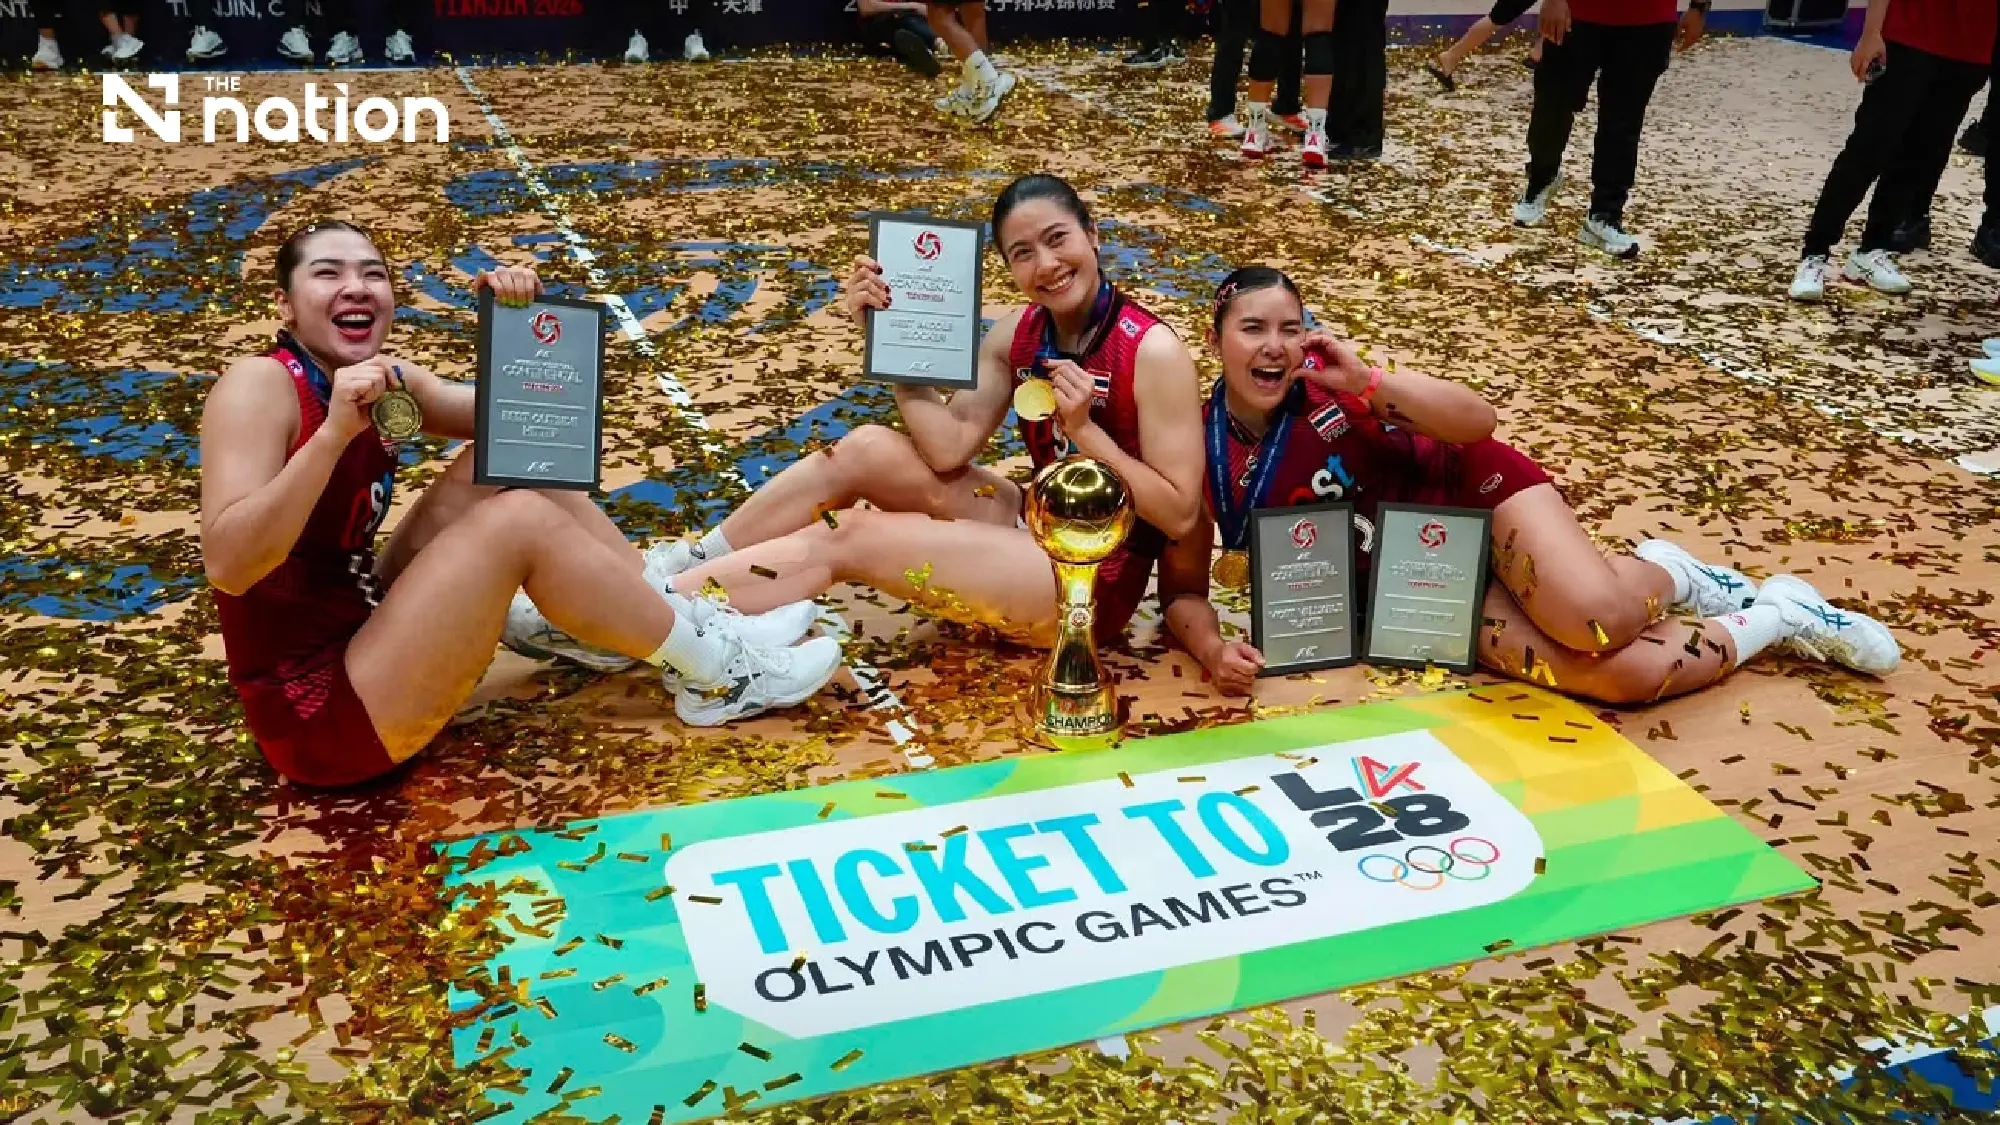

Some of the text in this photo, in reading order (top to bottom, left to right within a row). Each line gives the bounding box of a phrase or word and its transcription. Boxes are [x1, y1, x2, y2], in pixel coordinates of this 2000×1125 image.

[1309, 793, 1469, 852] 28
[711, 792, 1291, 955] TICKET TO
[754, 921, 1066, 1003] OLYMPIC
